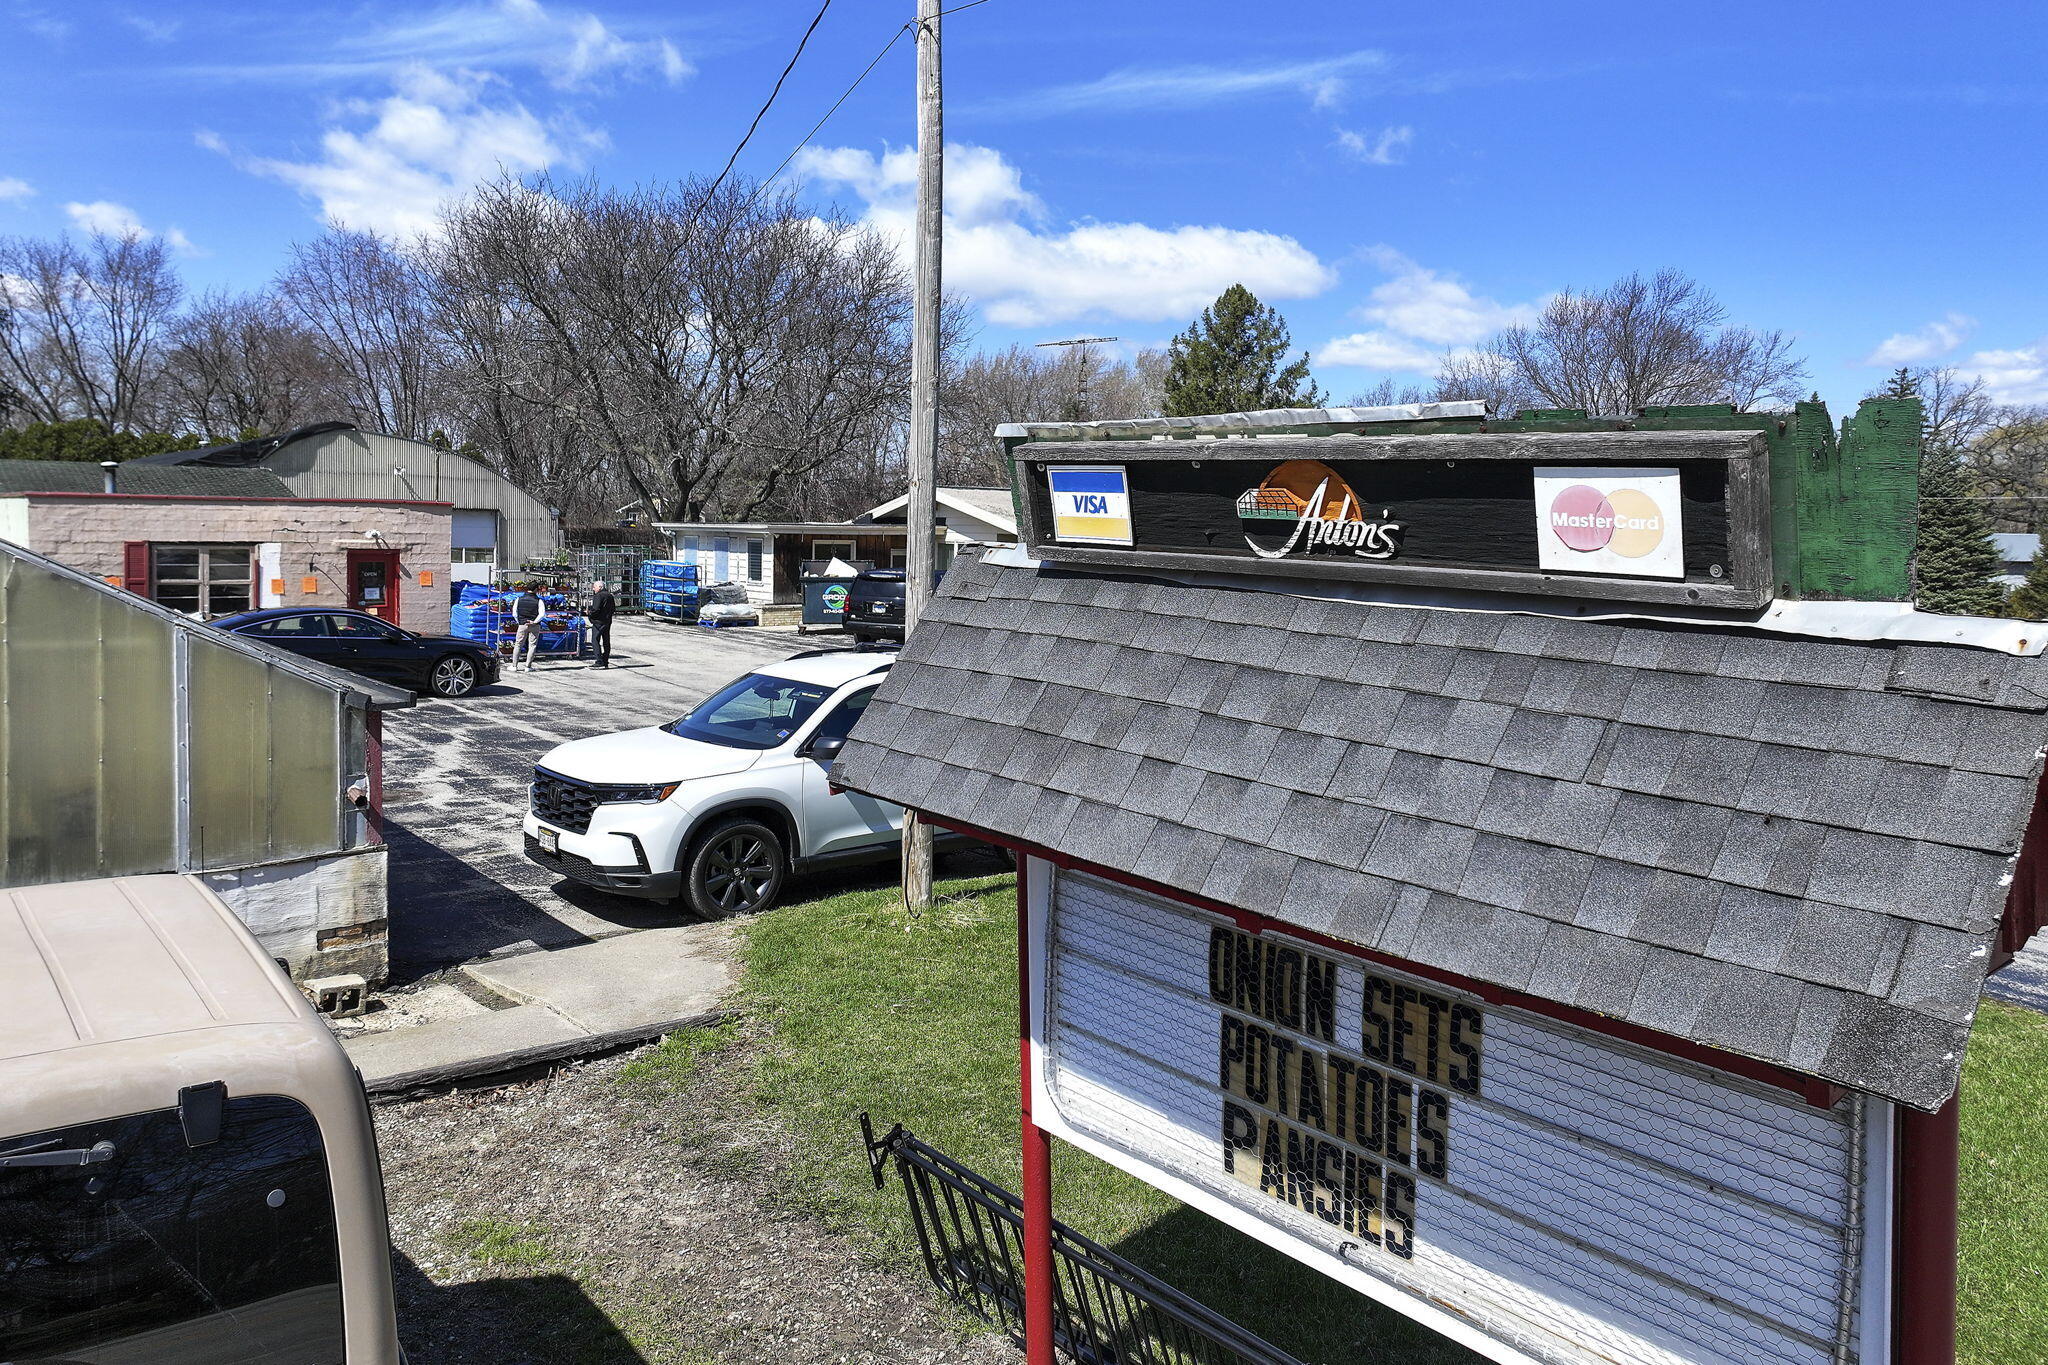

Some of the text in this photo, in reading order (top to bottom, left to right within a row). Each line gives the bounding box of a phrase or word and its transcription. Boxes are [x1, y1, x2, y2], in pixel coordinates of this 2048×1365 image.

[1072, 495, 1108, 514] VISA
[1244, 476, 1399, 559] Anton's
[1552, 512, 1660, 531] MasterCard
[1210, 927, 1482, 1095] ONION SETS
[1220, 1013, 1447, 1179] POTATOES
[1223, 1100, 1415, 1260] PANSIES
